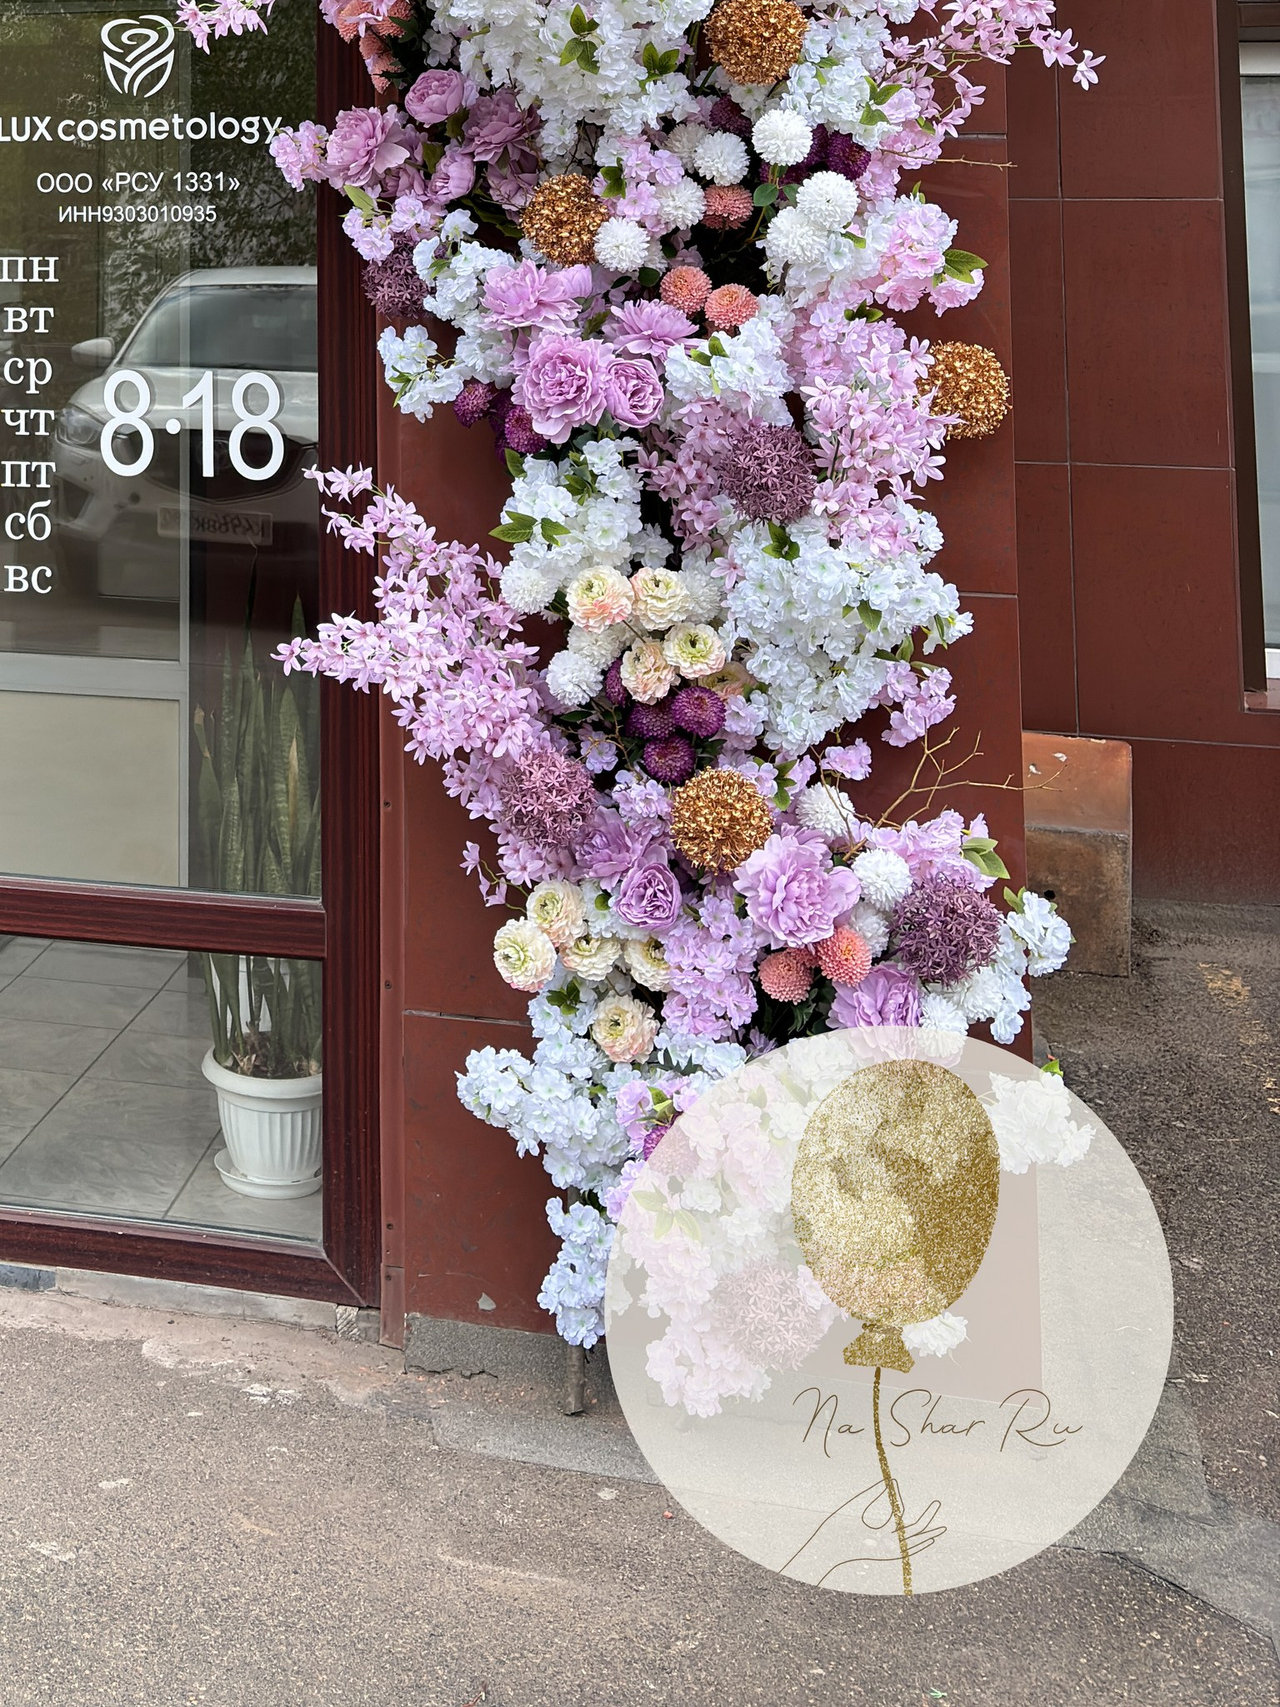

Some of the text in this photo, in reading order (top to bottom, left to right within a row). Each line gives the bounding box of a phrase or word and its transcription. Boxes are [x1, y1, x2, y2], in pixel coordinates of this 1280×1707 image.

[57, 111, 283, 145] cosmetology
[36, 170, 241, 194] ООО «РСУ 1331»
[58, 204, 217, 223] ИНН9303010935
[3, 305, 55, 334] вт
[3, 357, 53, 394] ср
[1, 408, 55, 437] чт
[1, 459, 56, 489] пт
[4, 500, 52, 541] сб
[3, 564, 53, 594] вс
